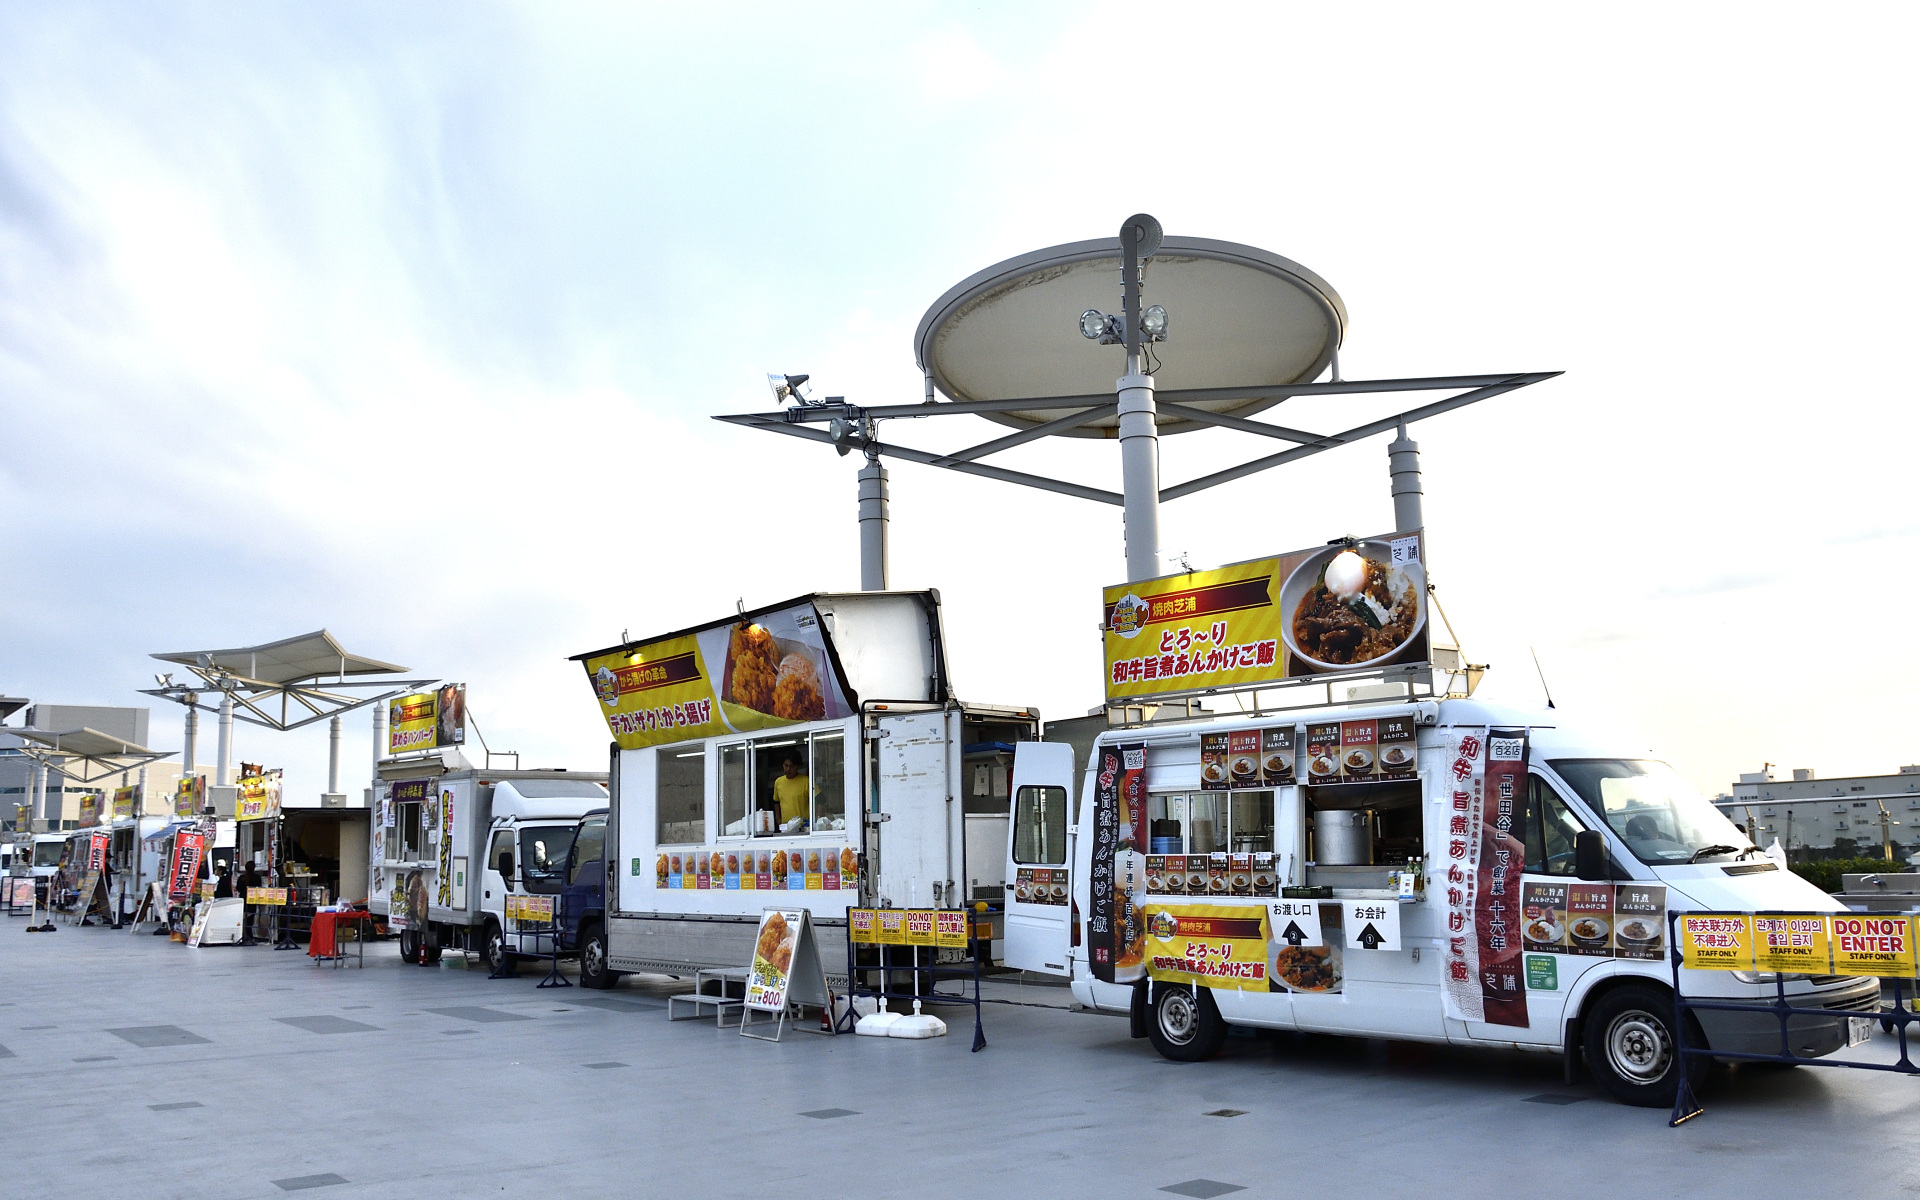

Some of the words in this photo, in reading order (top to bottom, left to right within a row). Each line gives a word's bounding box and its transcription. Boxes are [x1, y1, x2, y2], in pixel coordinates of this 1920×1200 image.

[1152, 598, 1197, 617] 焼肉芝浦
[1159, 622, 1227, 652] とろ〜り
[1112, 640, 1276, 683] 和牛旨煮あんかけご飯
[619, 665, 668, 689] から揚げの革命
[610, 699, 711, 735] デカ!ザク!から揚げ
[1388, 723, 1403, 732] 旨煮
[1496, 745, 1520, 756] 百名店
[1093, 753, 1118, 932] 和牛旨煮あんかけご飯
[1448, 736, 1480, 983] 和牛旨煮あんかけご飯
[1631, 893, 1650, 903] 旨煮
[907, 913, 917, 921] DO
[918, 913, 933, 921] NOT
[1273, 904, 1312, 916] お渡し口
[1355, 906, 1387, 920] お会計
[909, 922, 932, 932] ENTER
[938, 922, 965, 933] 立入禁止
[1179, 921, 1211, 934] 焼肉芝浦
[1687, 919, 1745, 933] 除关联方外
[1756, 919, 1788, 932] 관계자
[1790, 919, 1823, 933] 이외의
[1834, 920, 1864, 935] DO
[1866, 920, 1907, 936] NOT
[1693, 934, 1740, 948] 不得进入
[1767, 933, 1790, 946] 출입
[1791, 934, 1813, 947] 금지
[1840, 936, 1904, 952] ENTER
[1185, 942, 1232, 960] とろ〜り
[1769, 947, 1791, 955] STAFF
[1153, 956, 1266, 980] 和牛旨煮あんかけご飯
[1484, 972, 1517, 991] 芝浦
[762, 990, 780, 1005] 800
